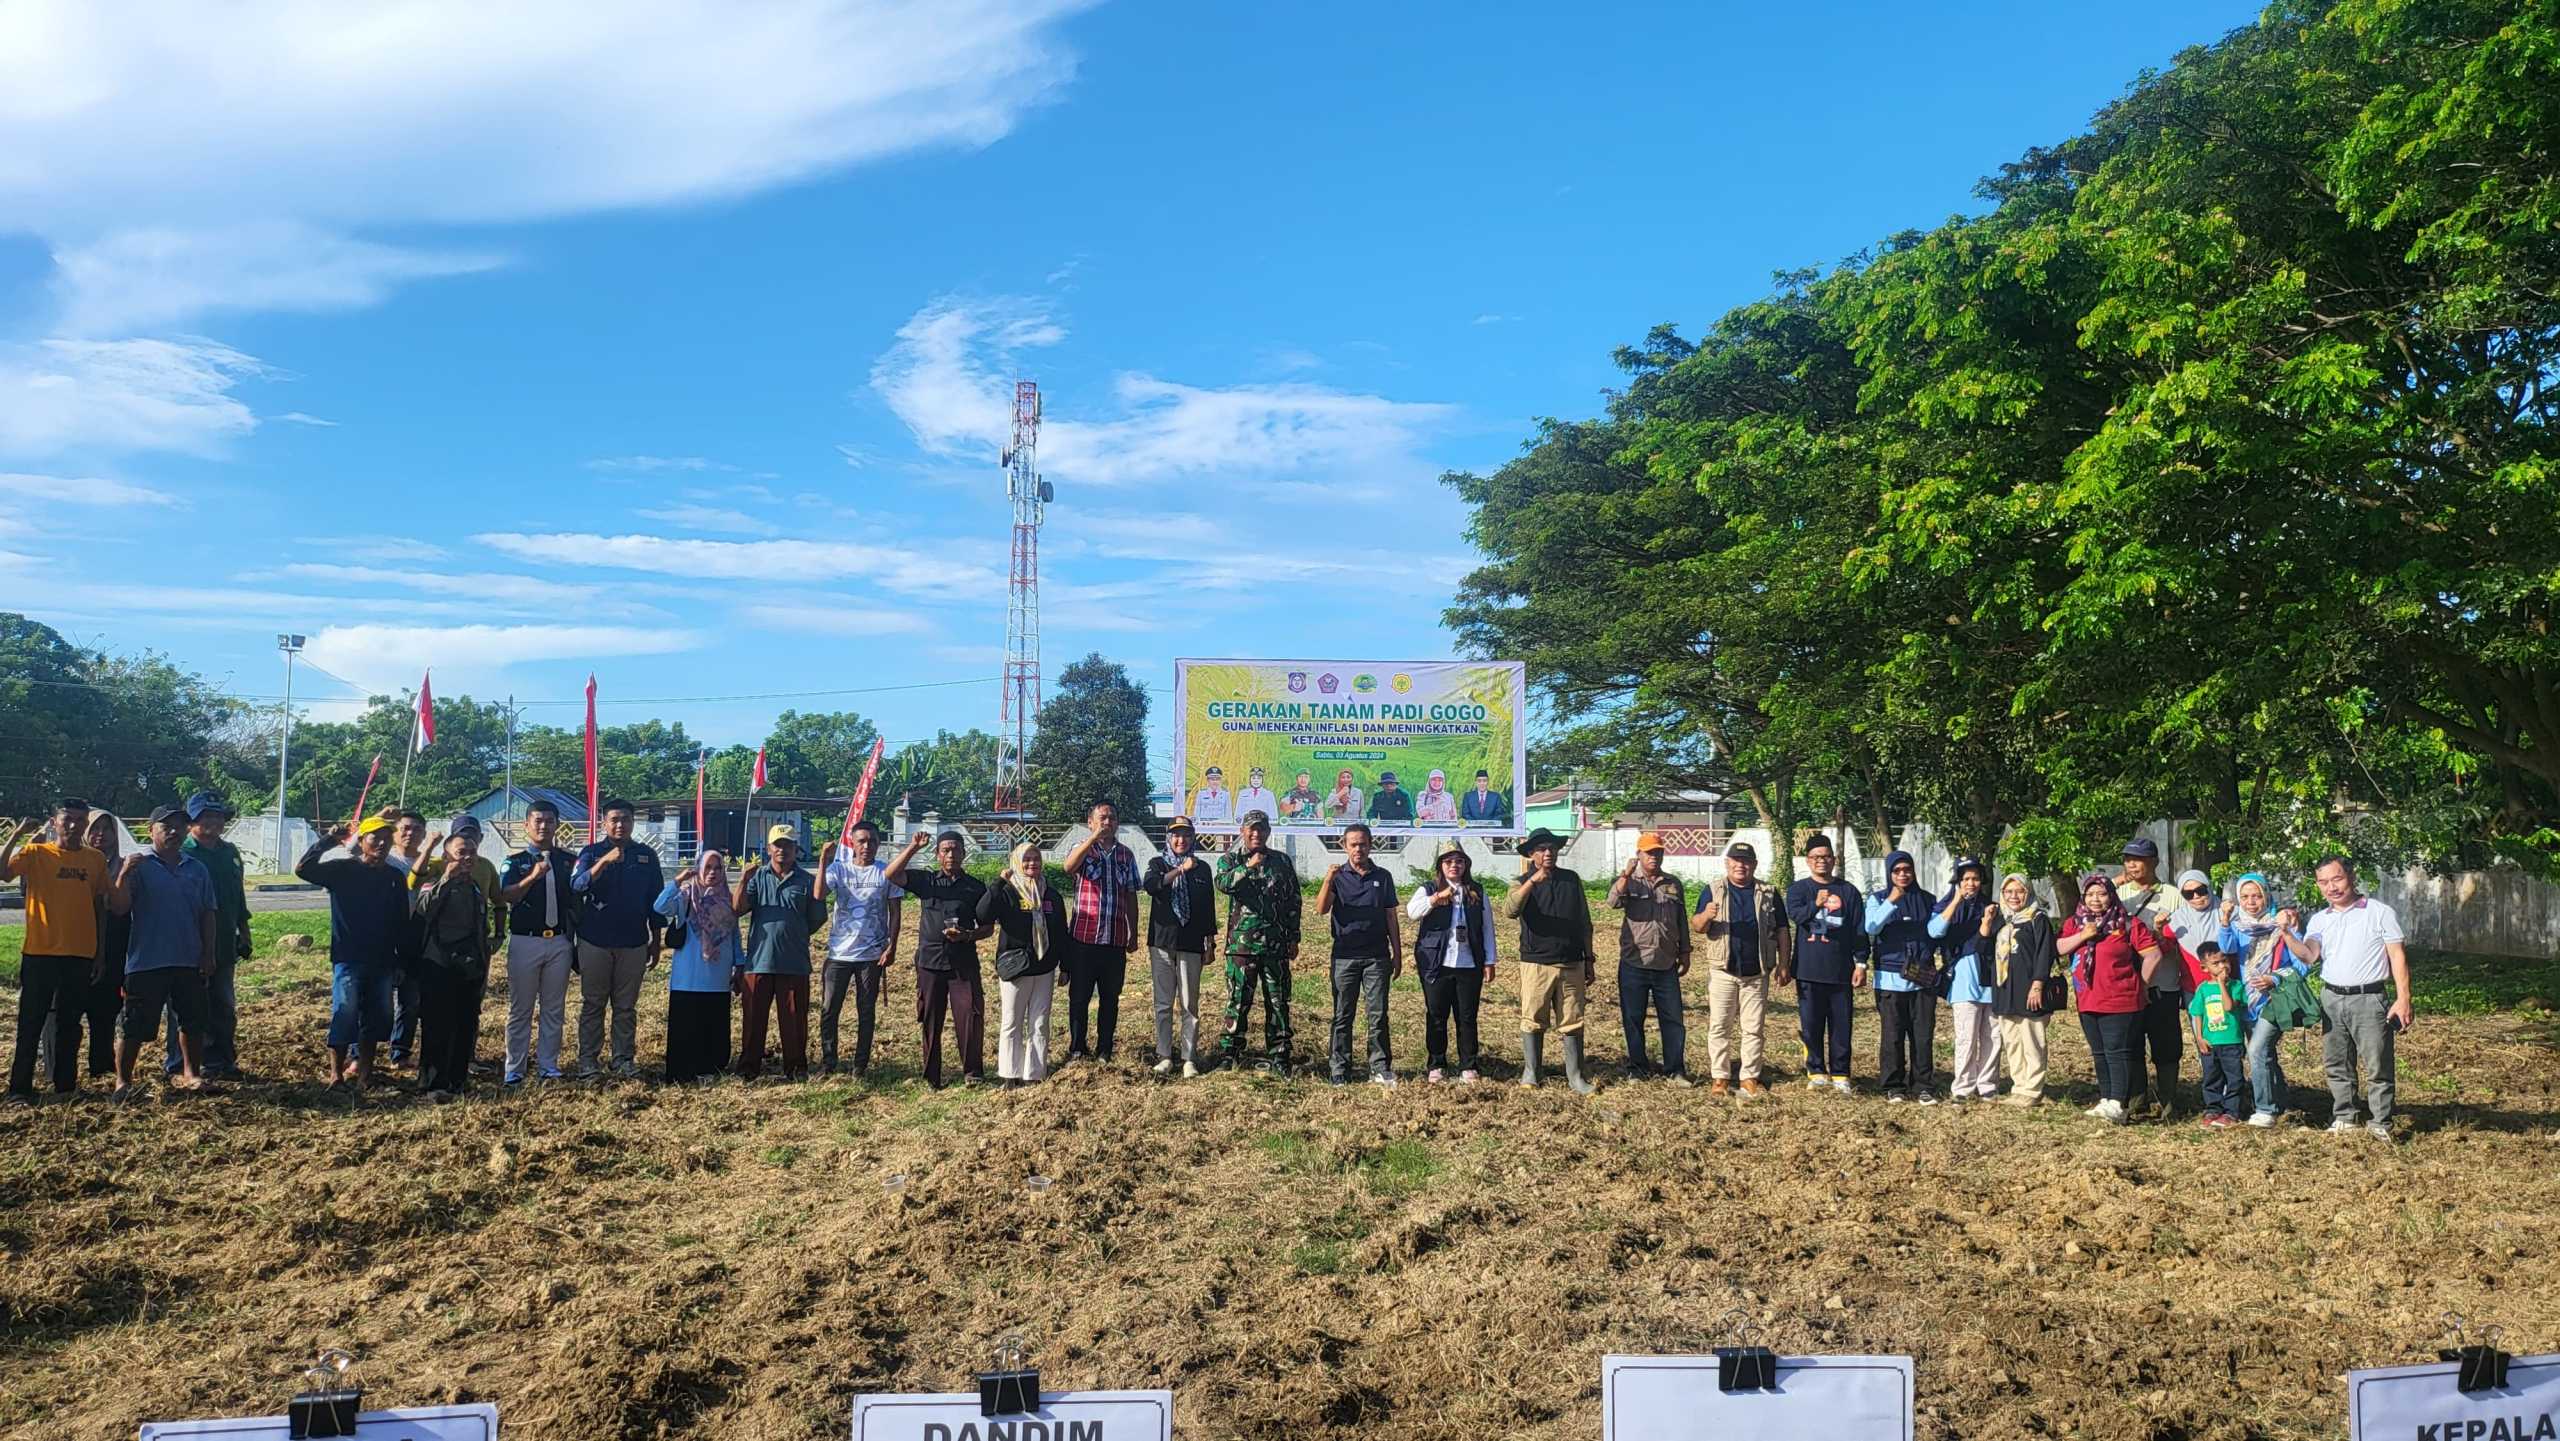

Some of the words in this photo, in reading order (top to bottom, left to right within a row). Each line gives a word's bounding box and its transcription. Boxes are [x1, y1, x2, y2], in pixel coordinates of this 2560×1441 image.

[1208, 702, 1301, 719] GERAKAN
[1308, 703, 1374, 720] TANAM
[1381, 704, 1423, 720] PADI
[1430, 704, 1486, 721] GOGO
[1222, 722, 1253, 731] GUNA
[1257, 722, 1312, 732] MENEKAN
[1316, 722, 1359, 733] INFLASI
[1362, 723, 1385, 733] DAN
[1388, 724, 1478, 734] MENINGKATKAN
[1291, 735, 1360, 745] KETAHANAN
[1363, 736, 1409, 746] PANGAN
[1344, 752, 1368, 760] Agustus
[923, 1421, 1103, 1441] DANDIM
[2417, 1413, 2557, 1441] KEPALA
